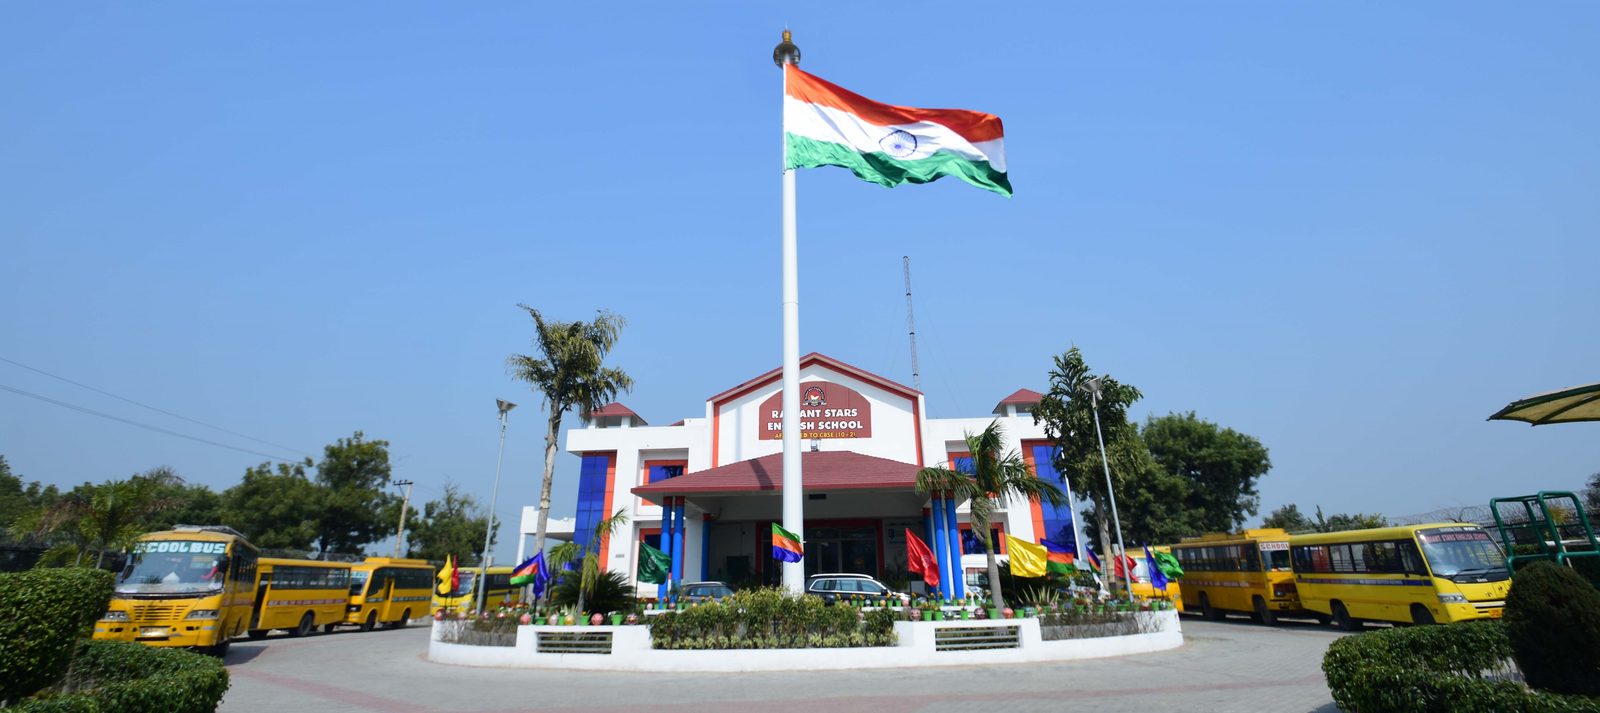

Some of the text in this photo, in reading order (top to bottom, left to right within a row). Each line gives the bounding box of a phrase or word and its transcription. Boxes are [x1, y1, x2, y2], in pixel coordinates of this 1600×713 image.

[771, 408, 858, 419] RANT STARS
[767, 420, 863, 431] ENSH SCHOOL
[189, 542, 226, 554] BUS
